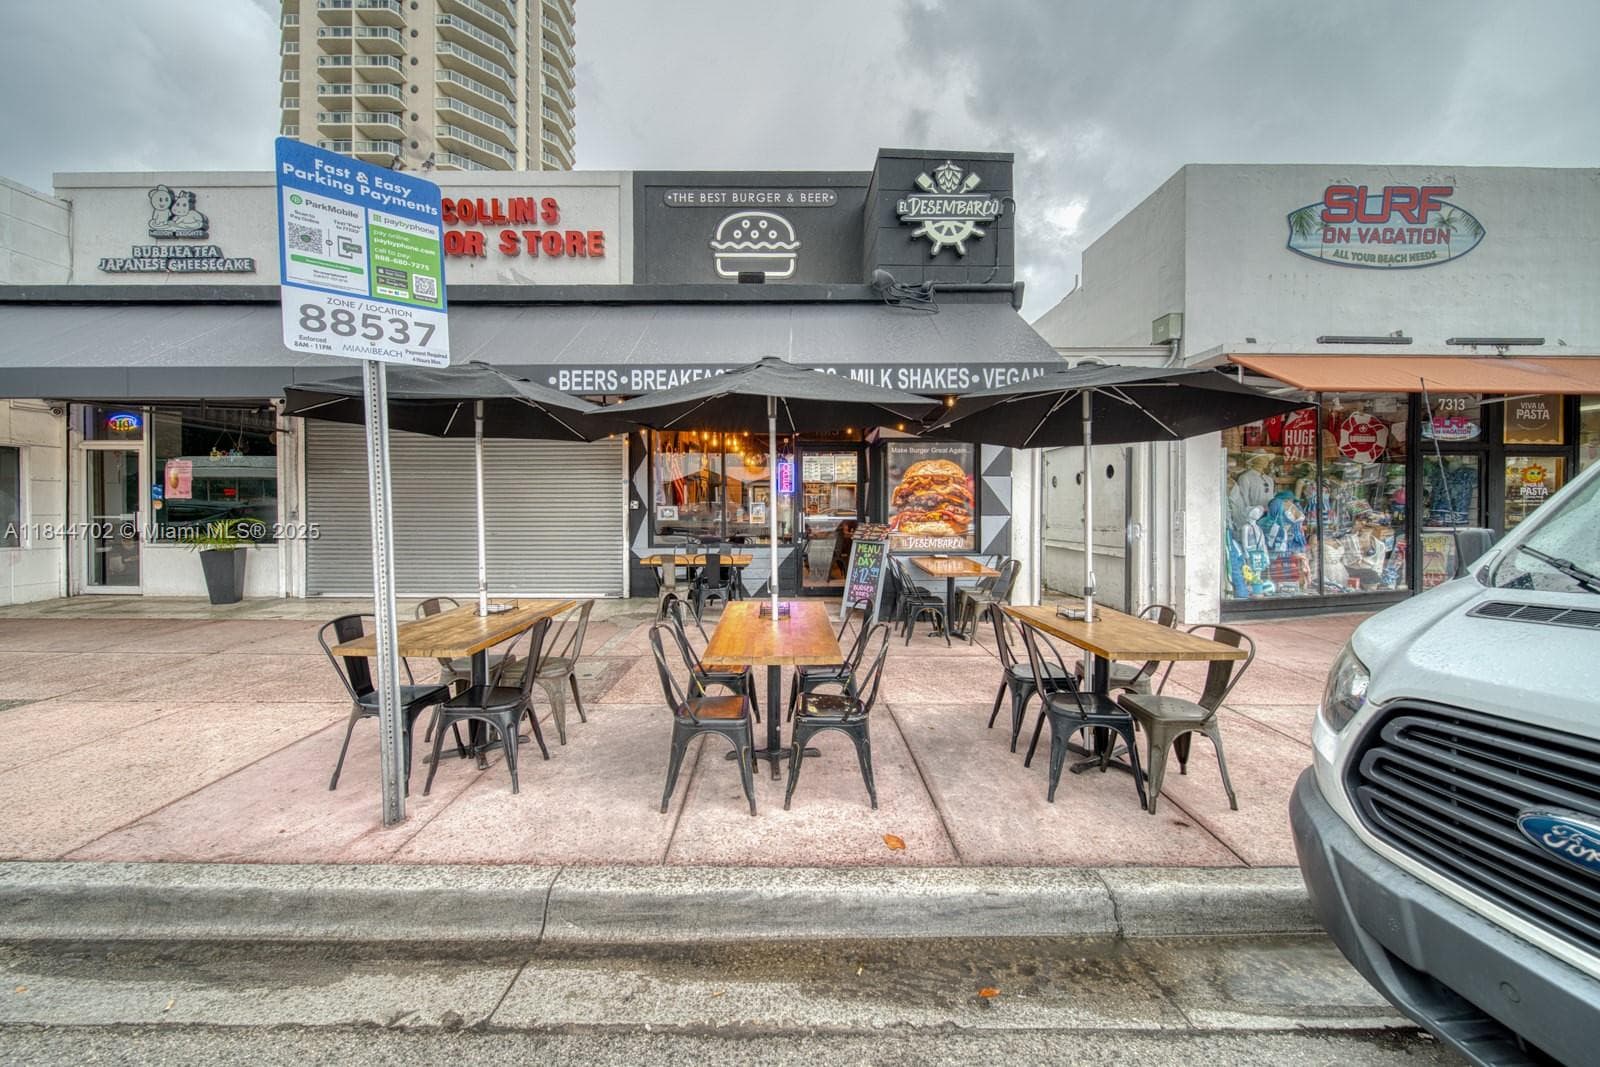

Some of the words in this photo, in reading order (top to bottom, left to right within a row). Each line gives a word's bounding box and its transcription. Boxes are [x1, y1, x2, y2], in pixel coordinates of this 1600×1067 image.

[314, 158, 351, 179] Fast
[355, 171, 369, 185] &
[374, 176, 412, 198] Easy
[282, 162, 355, 196] Parking
[360, 184, 439, 216] Payments
[672, 192, 694, 203] THE
[700, 192, 727, 203] BEST
[732, 192, 781, 203] BURGER
[786, 192, 795, 203] &
[800, 192, 829, 203] BEER
[305, 198, 359, 219] ParkMobile
[907, 197, 1000, 217] DESEMBARCO
[1321, 185, 1454, 224] SURF
[384, 217, 435, 235] paybyphone
[498, 229, 606, 258] STORE
[1322, 227, 1350, 244] ON
[1358, 227, 1451, 245] VACATION
[98, 258, 167, 271] JAPANESE
[167, 258, 251, 271] CHEESECAKE
[1332, 249, 1349, 260] ALL
[1351, 251, 1377, 263] YOUR
[1377, 252, 1408, 264] BEACH
[1409, 250, 1437, 262] NEEDS
[326, 297, 356, 309] ZONE
[366, 304, 413, 318] LOCATION
[299, 303, 436, 348] 88537
[314, 343, 332, 351] 11PM
[559, 369, 618, 391] BEERS
[898, 367, 970, 390] SHAKES
[1438, 398, 1465, 411] 7313
[1520, 401, 1537, 409] VIVA
[1537, 401, 1546, 409] LA
[1516, 409, 1550, 420] PASTA
[1284, 429, 1315, 445] HUGE
[1283, 446, 1314, 462] SALE
[1519, 487, 1549, 496] PASTA
[857, 543, 881, 554] MENU
[857, 557, 876, 568] DAY
[1543, 825, 1600, 862] For
